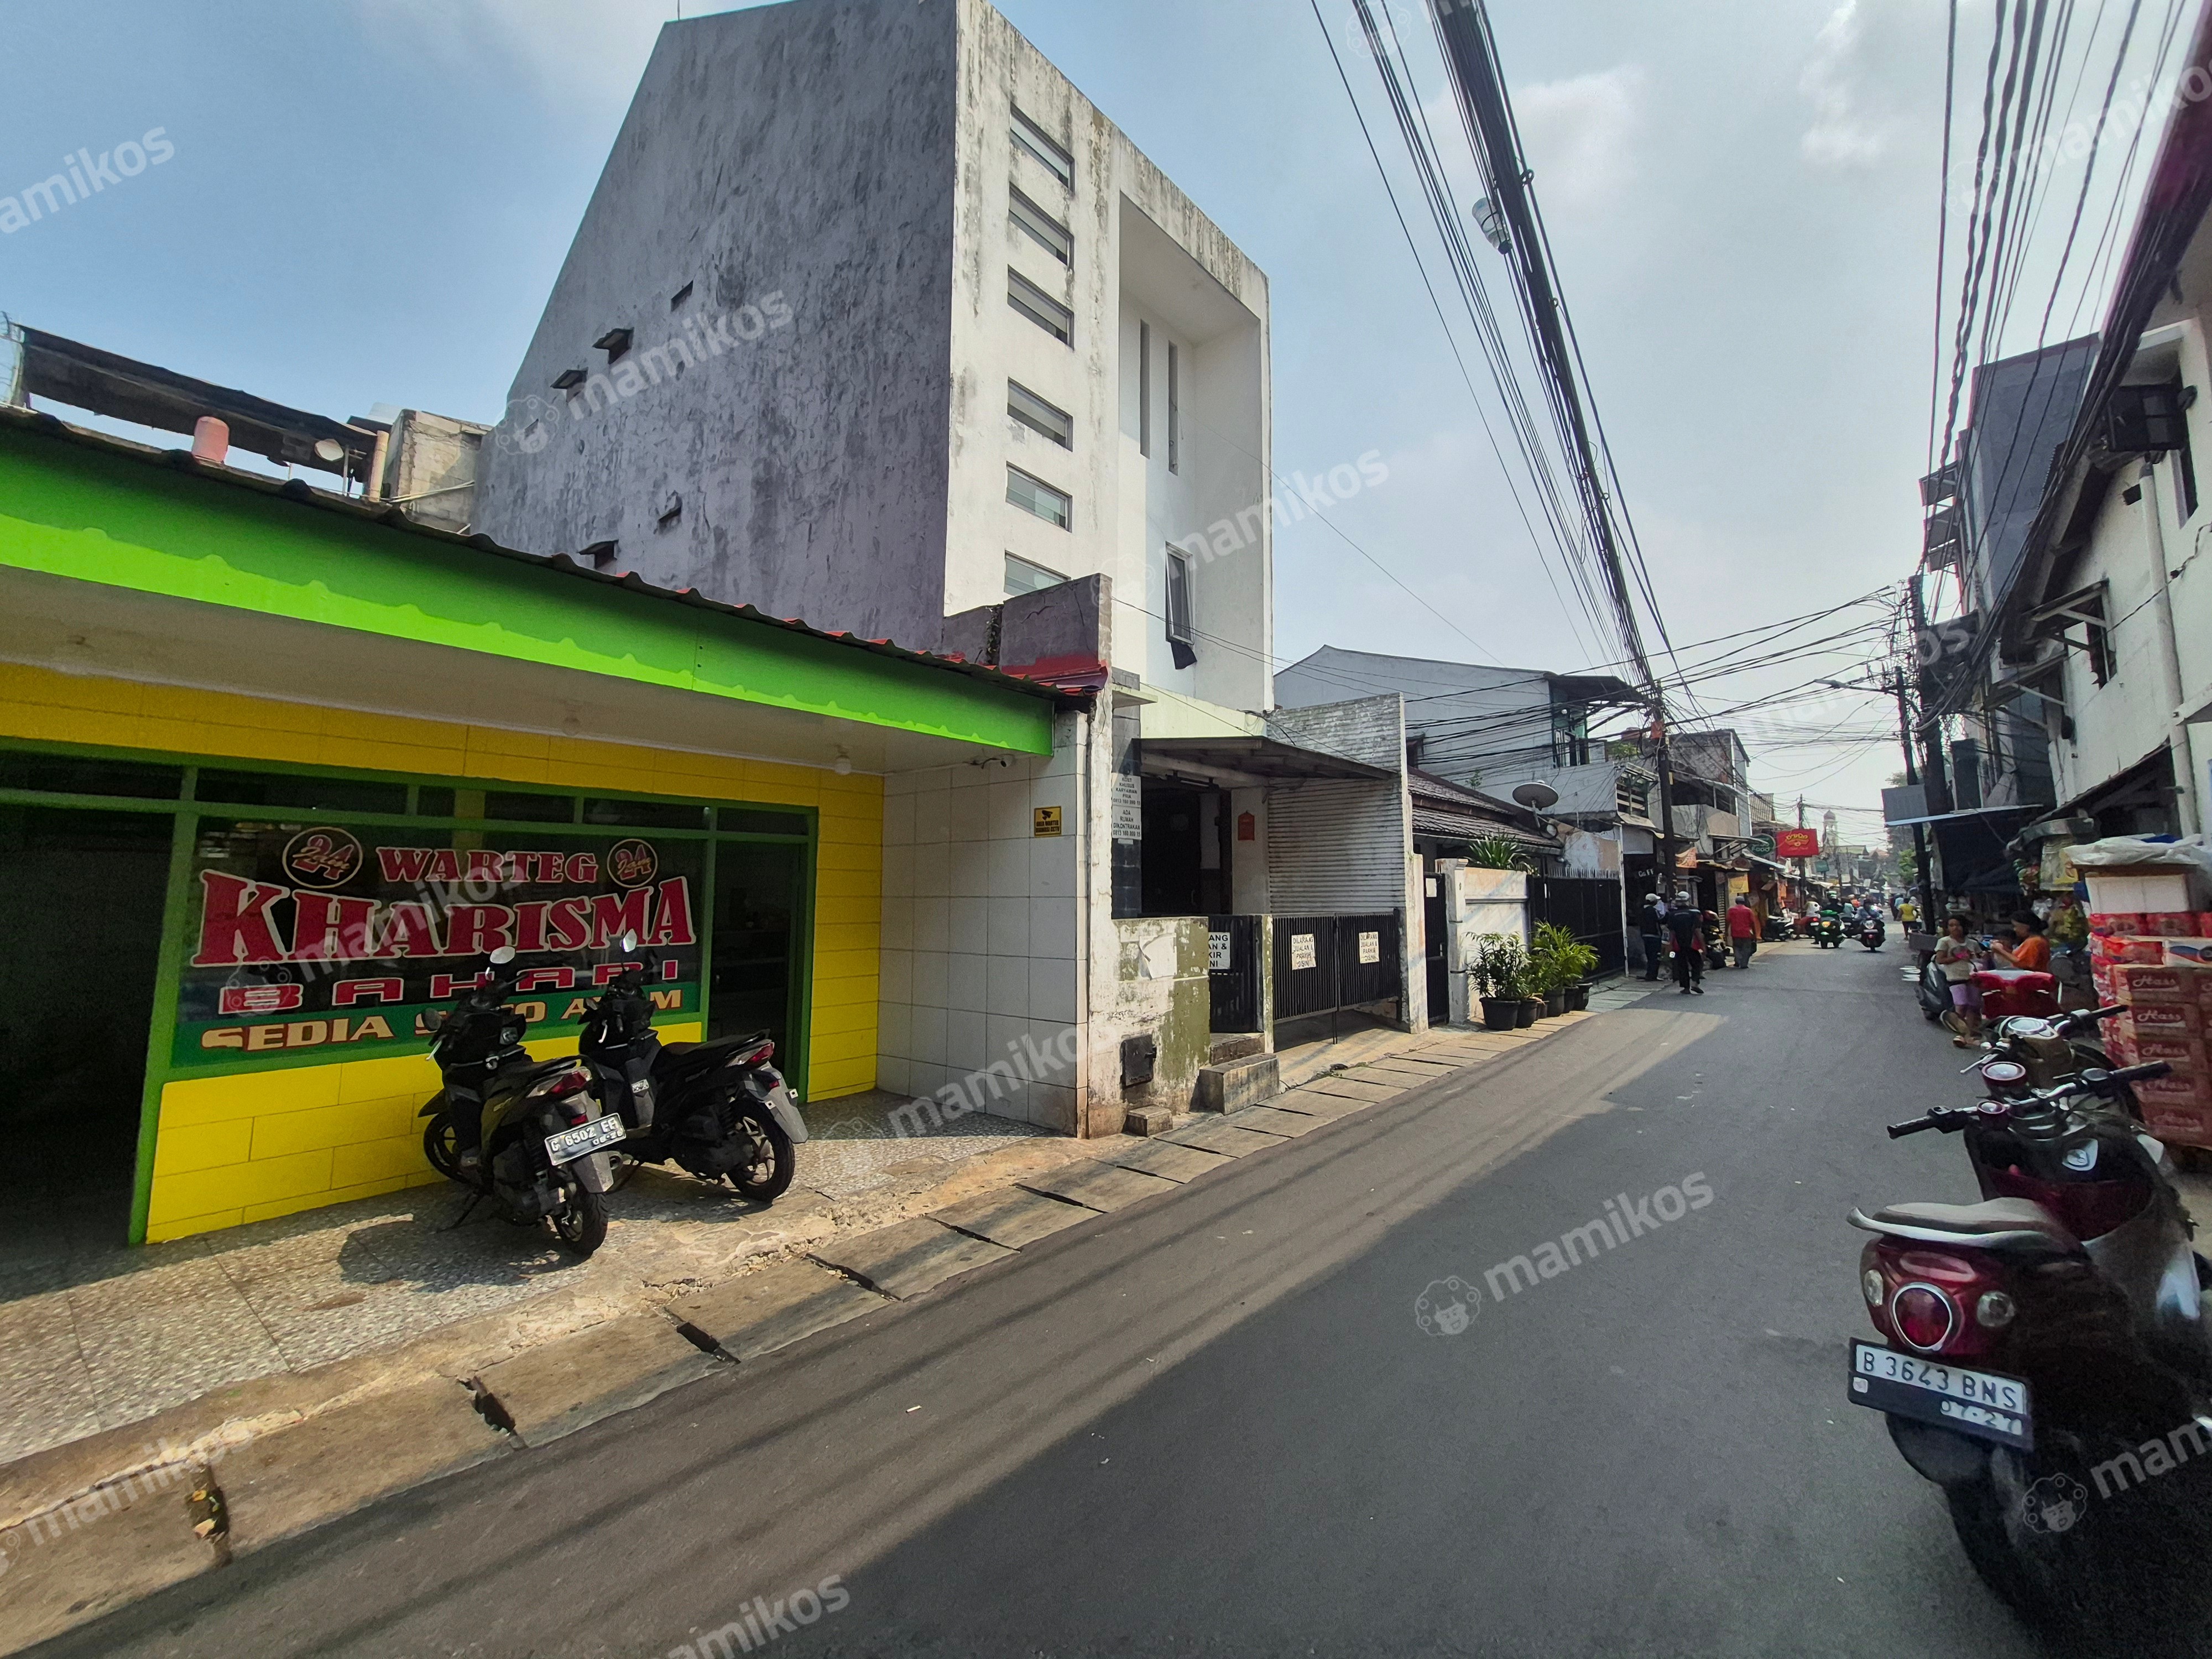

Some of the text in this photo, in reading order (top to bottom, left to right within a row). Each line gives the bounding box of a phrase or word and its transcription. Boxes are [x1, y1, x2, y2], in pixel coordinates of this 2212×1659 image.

[375, 846, 598, 883] WARTEG
[190, 869, 696, 967] KHARISMA
[201, 1015, 395, 1051] SEDIA
[564, 1126, 597, 1147] 6502
[1864, 1352, 2016, 1408] B 3643 BNS
